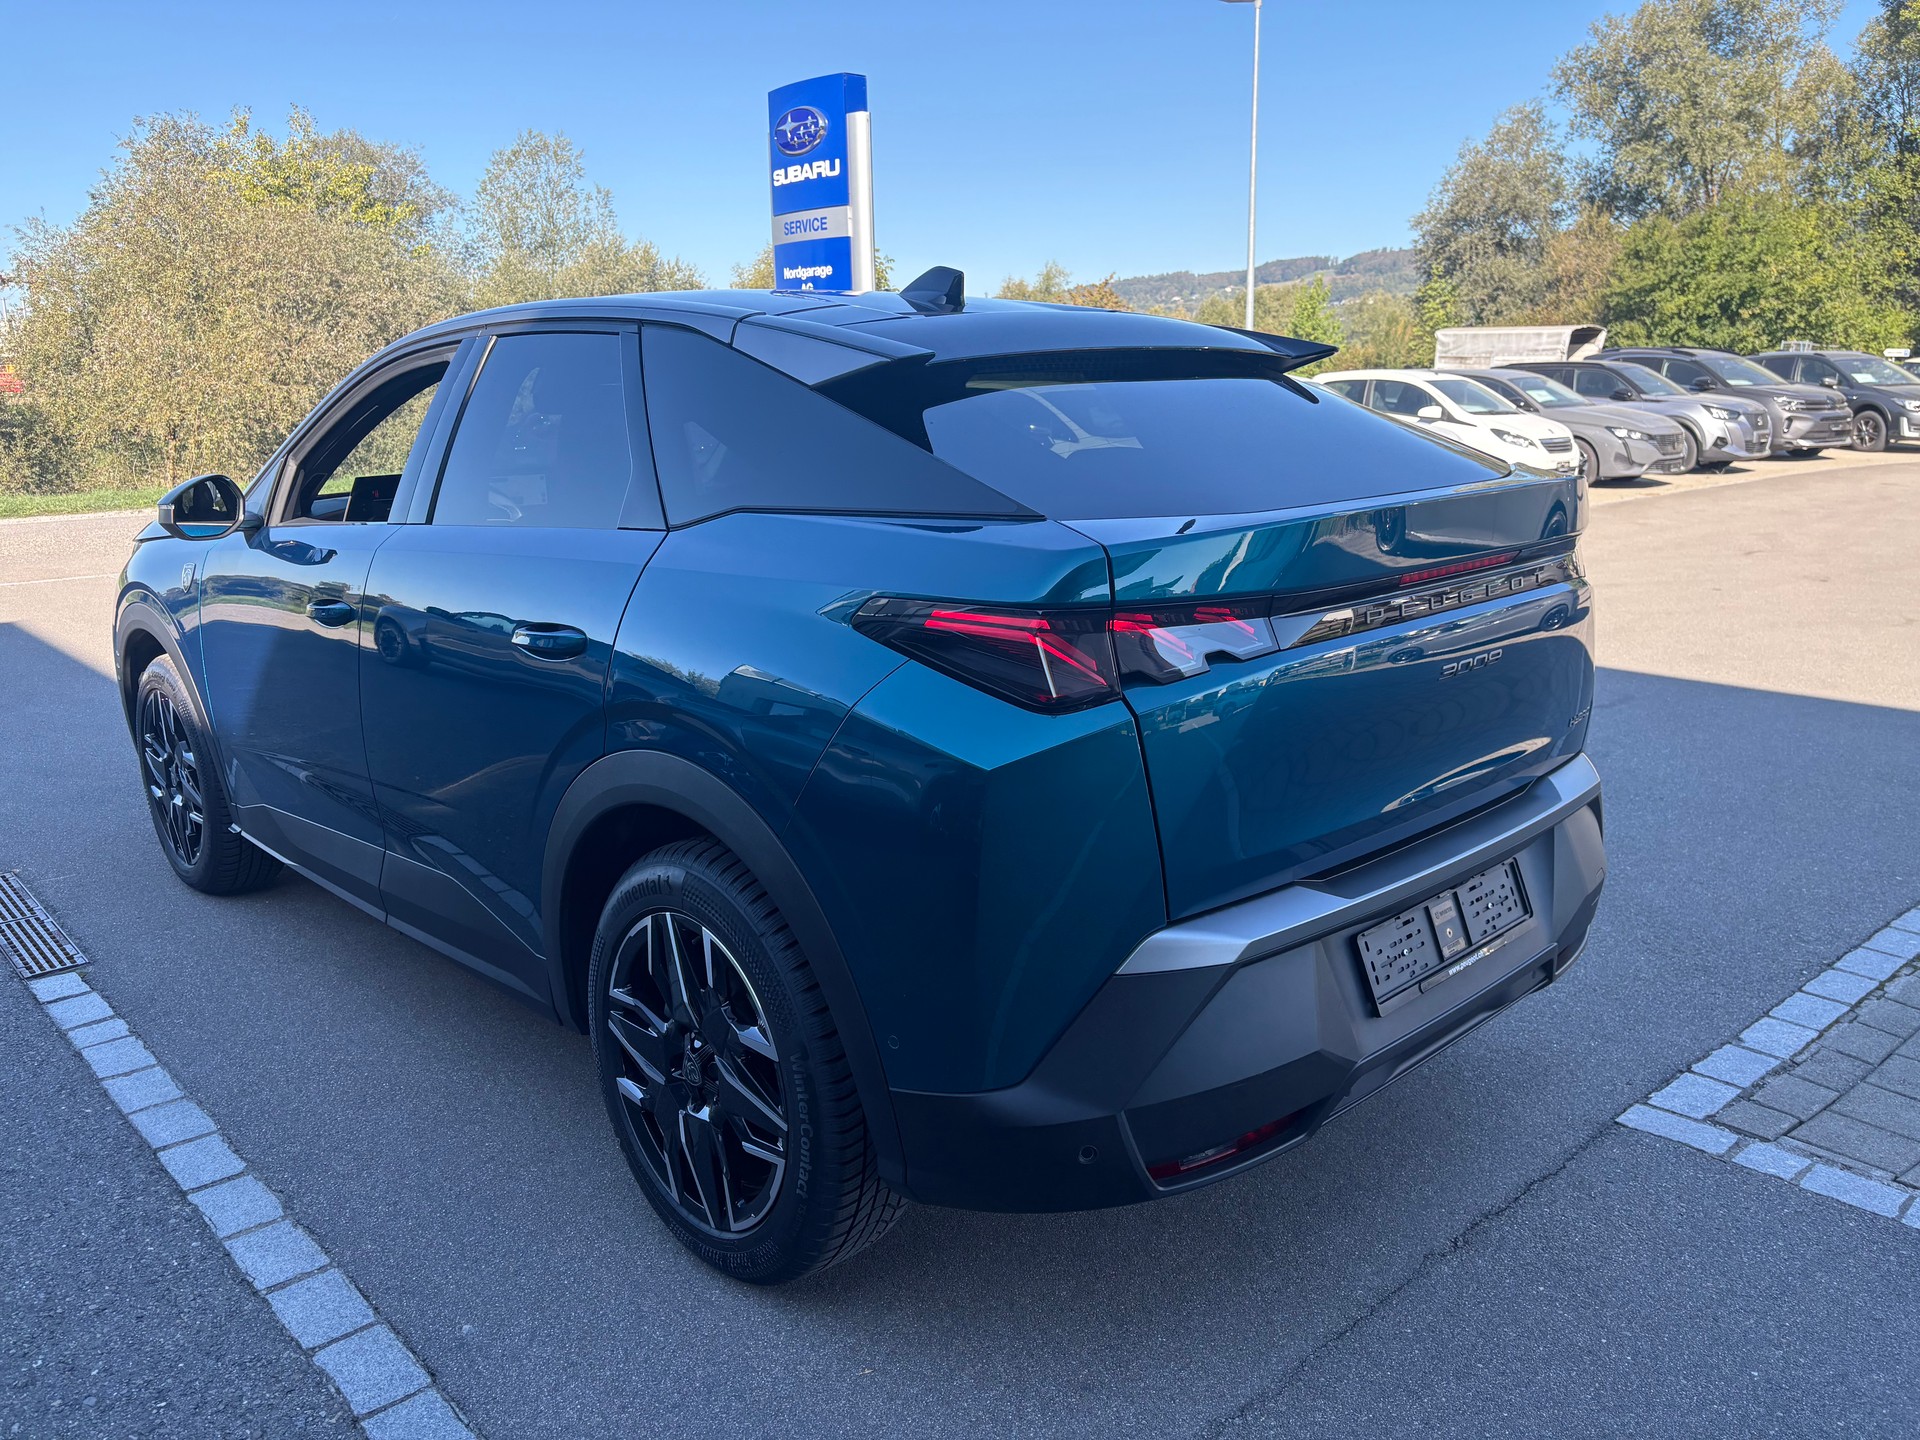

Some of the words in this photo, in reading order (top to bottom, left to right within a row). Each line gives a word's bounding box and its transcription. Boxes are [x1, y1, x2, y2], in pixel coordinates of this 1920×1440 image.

[773, 158, 841, 186] SUBARU
[784, 217, 828, 236] SERVICE
[783, 265, 833, 280] Nordgarage
[1366, 569, 1546, 624] PEUGEOT
[789, 1051, 815, 1198] WinterContact
